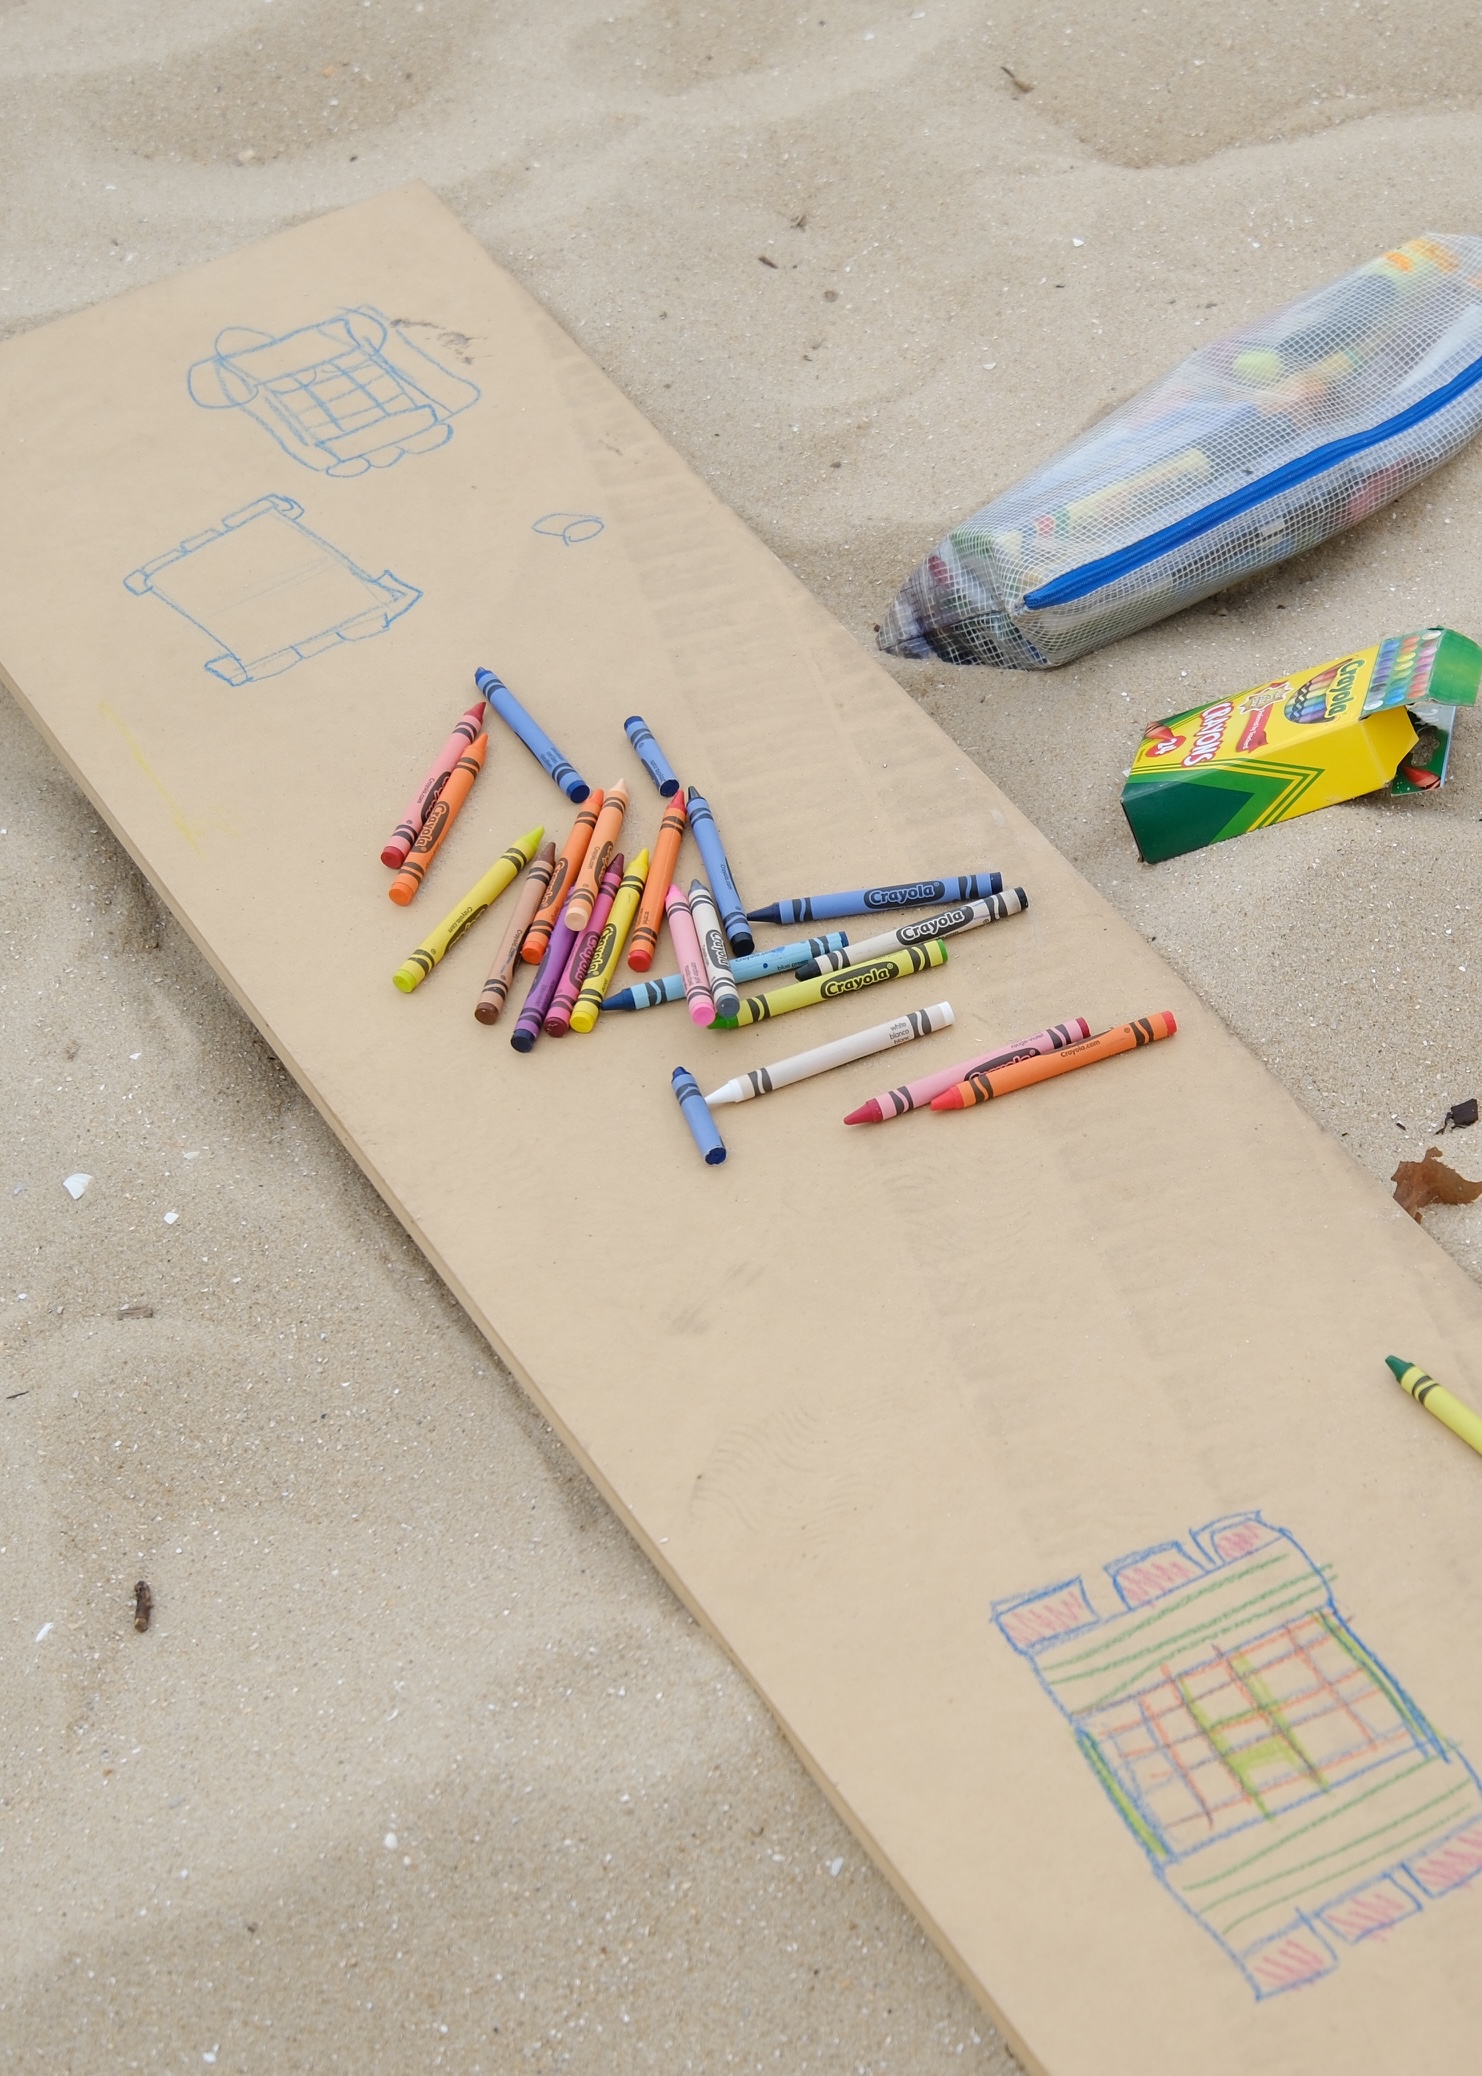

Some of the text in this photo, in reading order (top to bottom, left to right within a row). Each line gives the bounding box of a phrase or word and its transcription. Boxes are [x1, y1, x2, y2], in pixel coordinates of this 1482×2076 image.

[1323, 658, 1366, 717] Crayola
[1155, 738, 1177, 755] 24
[1182, 701, 1233, 767] CRAYONS
[415, 803, 447, 849] Crayola
[868, 882, 935, 905] Crayola
[447, 905, 473, 933] Crayola.com
[899, 907, 965, 942] Crayola
[574, 932, 599, 982] Crayola
[709, 929, 730, 966] Crayola
[777, 962, 790, 970] blue
[824, 965, 889, 997] Crayola
[888, 1028, 909, 1039] blanco
[889, 1020, 906, 1031] white
[1060, 1039, 1100, 1057] Crayola.com
